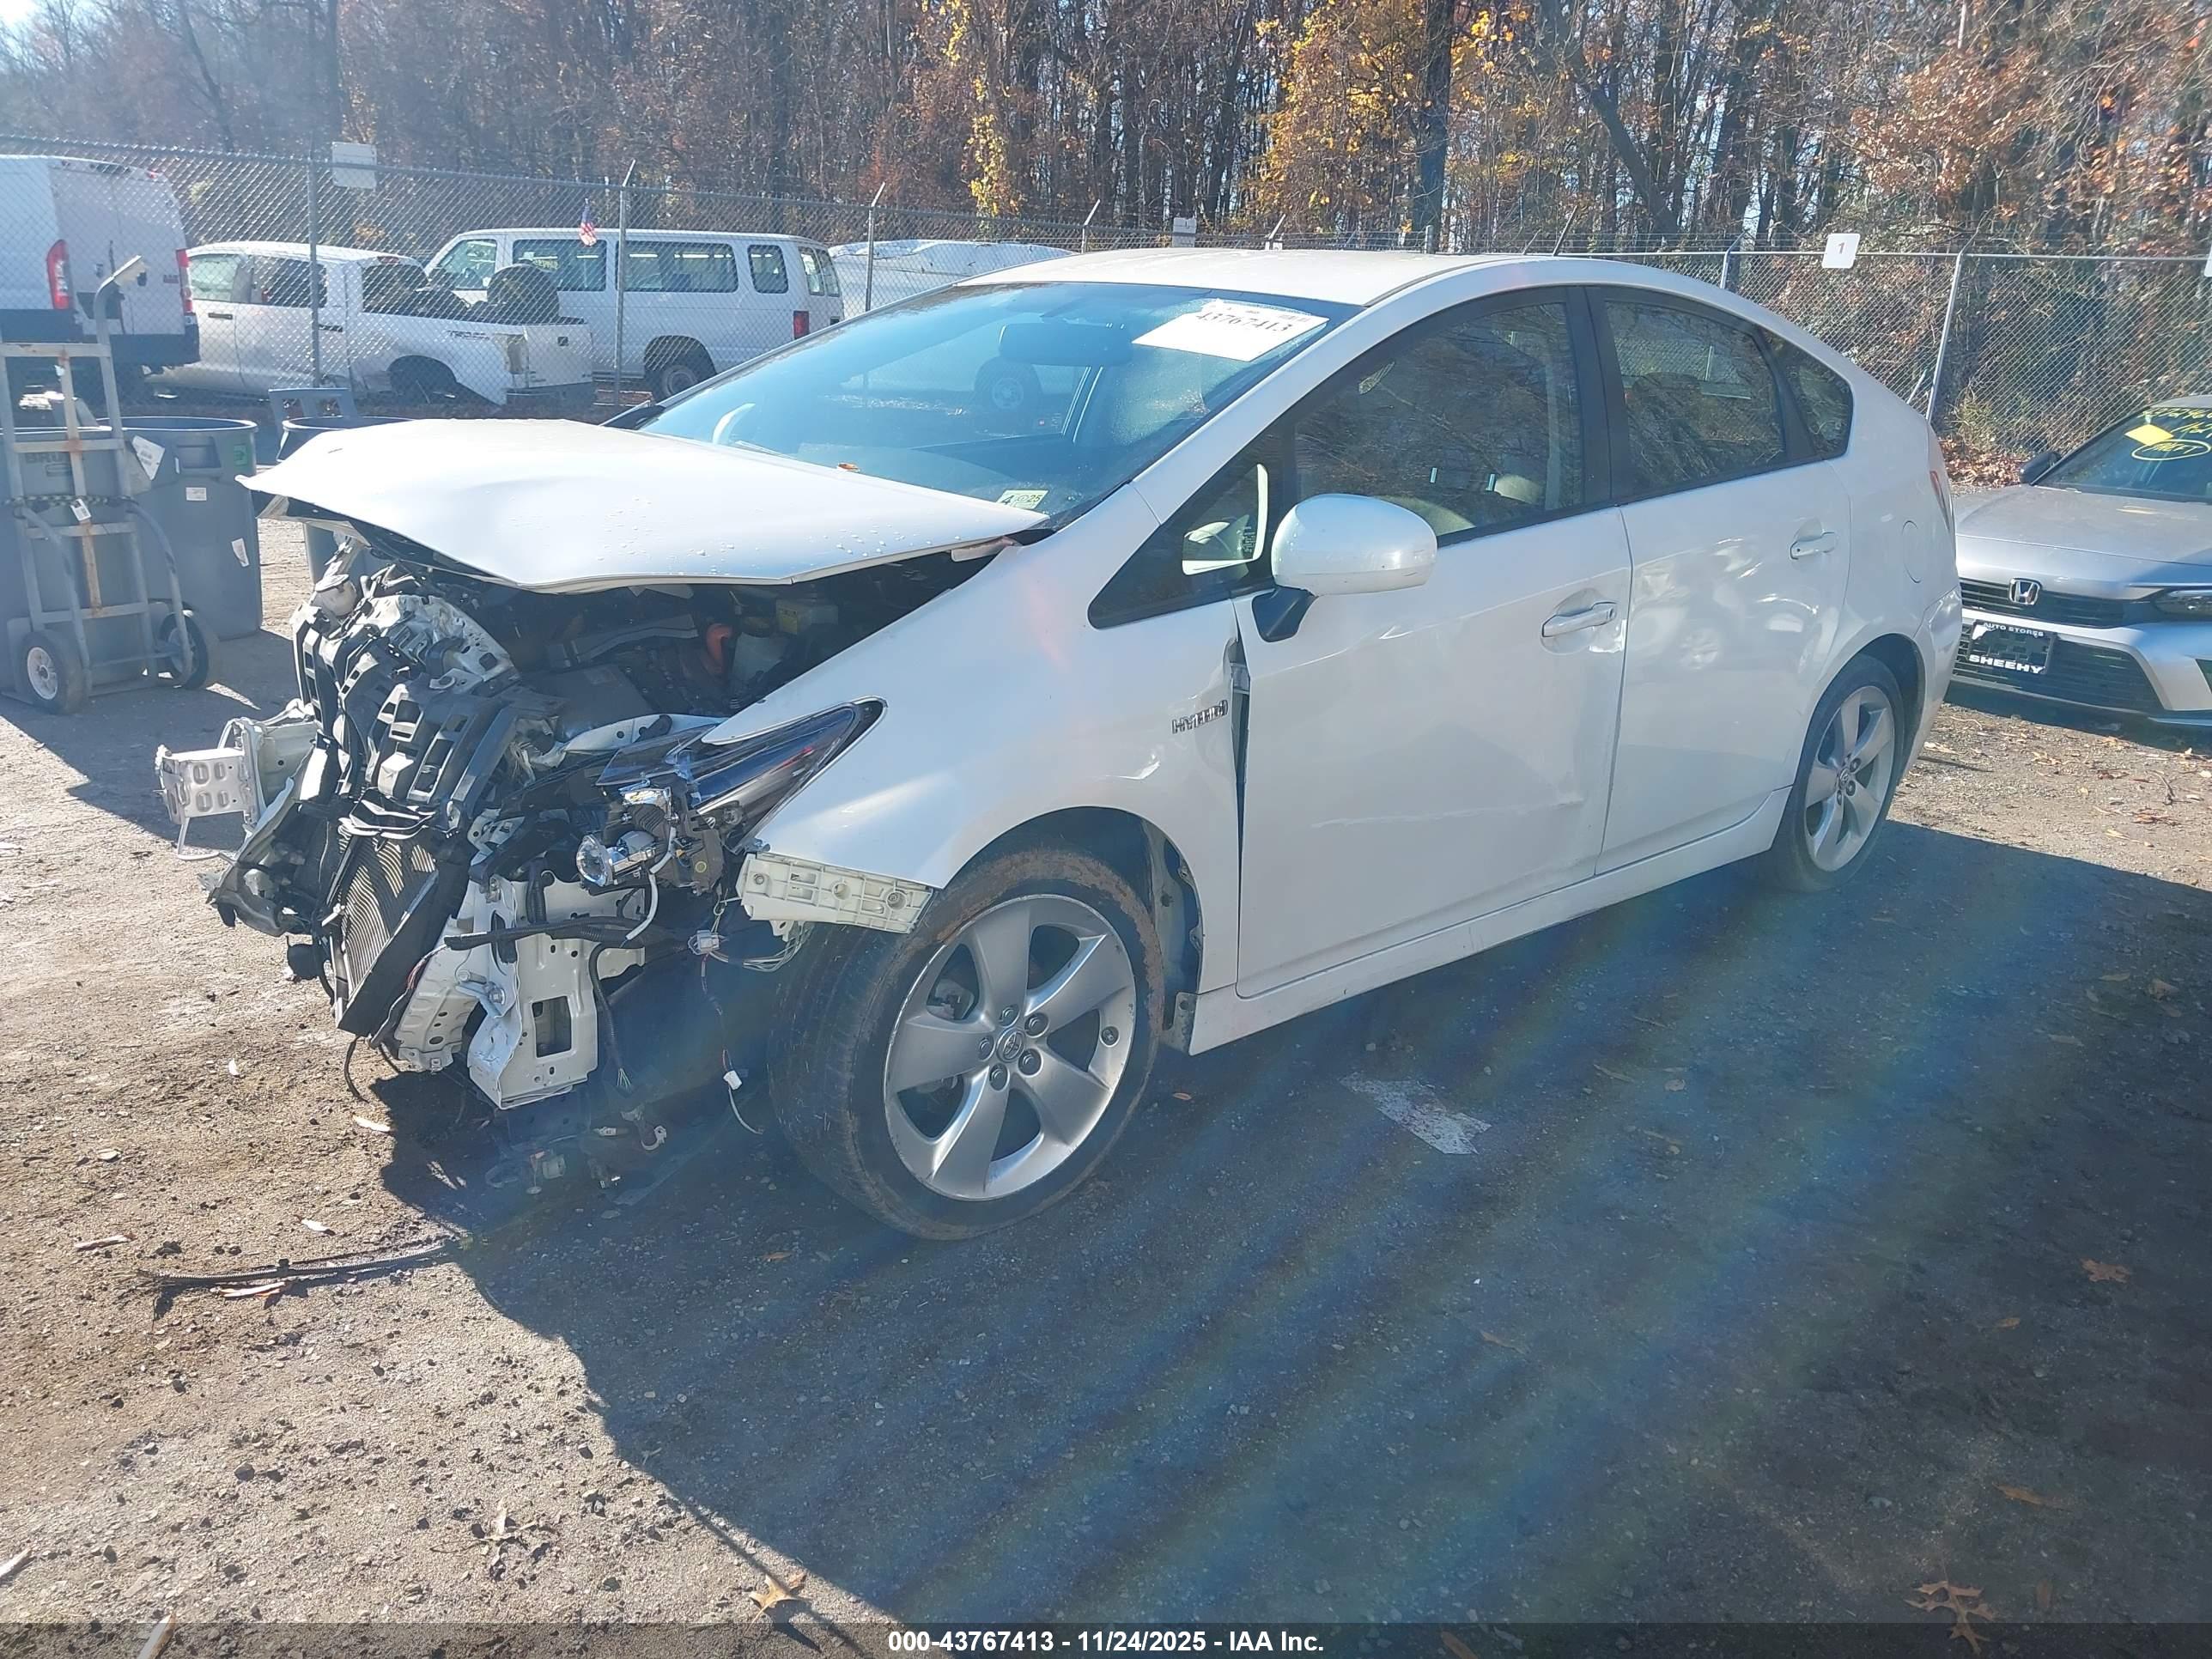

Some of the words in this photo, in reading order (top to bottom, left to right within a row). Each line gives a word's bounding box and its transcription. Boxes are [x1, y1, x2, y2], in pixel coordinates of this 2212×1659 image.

[1838, 242, 1844, 254] 1
[1001, 495, 1014, 505] 4
[1969, 654, 2045, 674] SHEEHY
